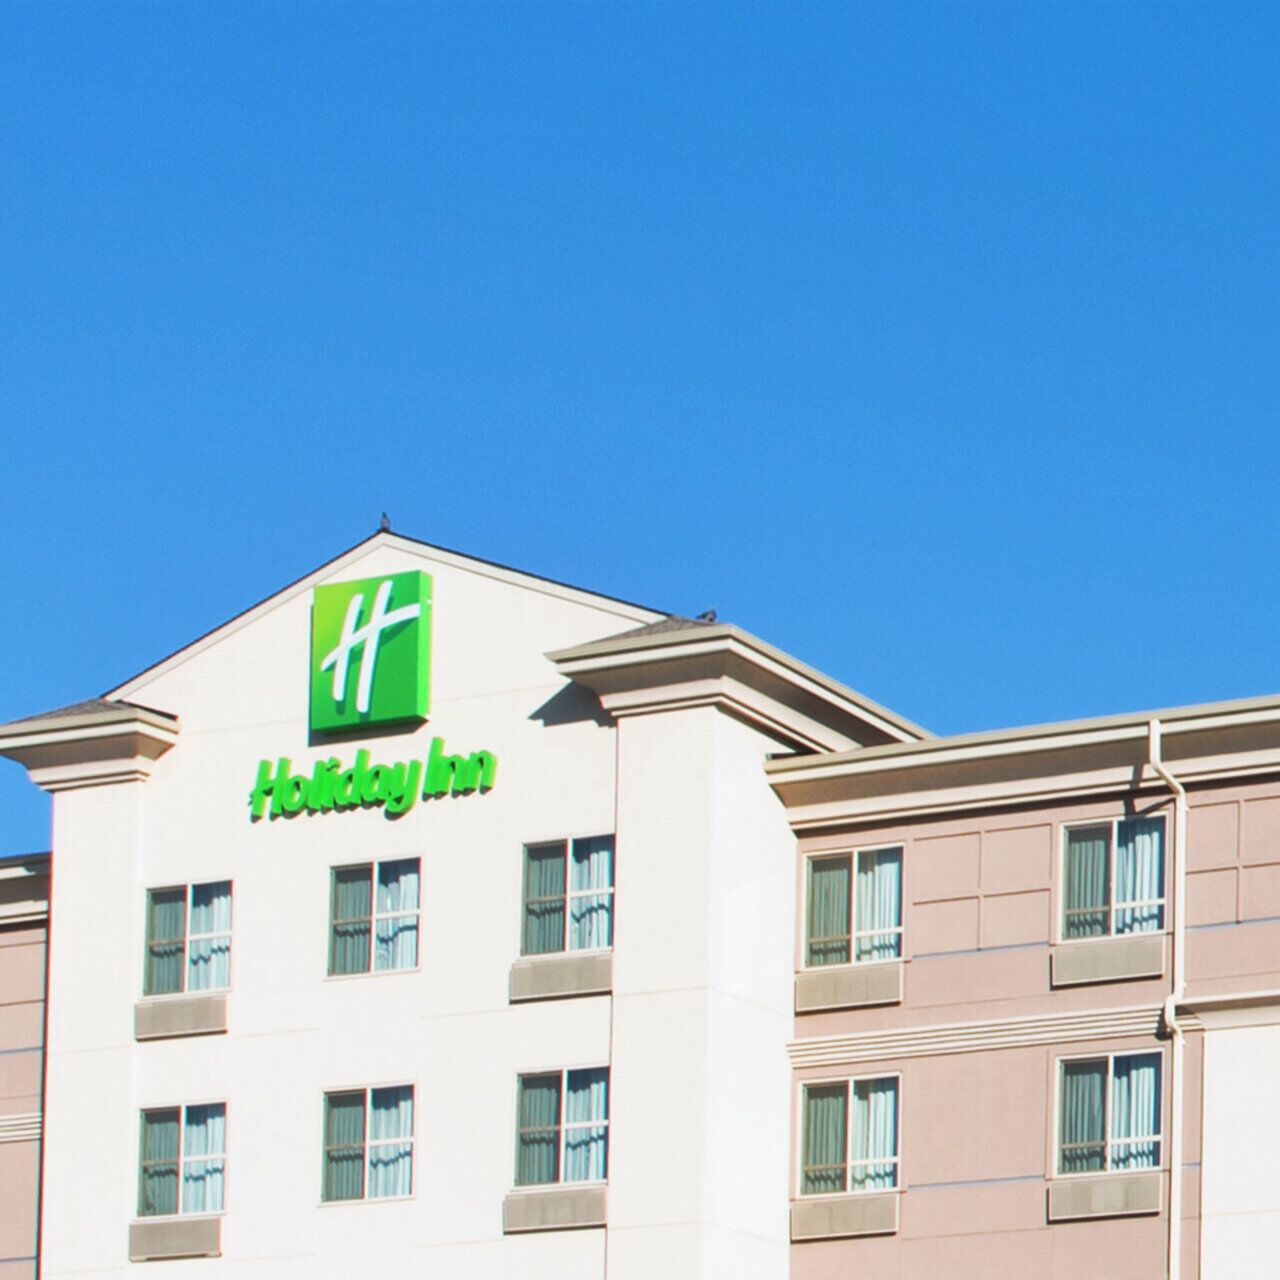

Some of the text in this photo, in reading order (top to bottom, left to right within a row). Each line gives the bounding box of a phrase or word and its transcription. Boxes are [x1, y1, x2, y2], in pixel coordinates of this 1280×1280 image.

[320, 580, 420, 713] H
[249, 736, 497, 819] Holiday Inn
